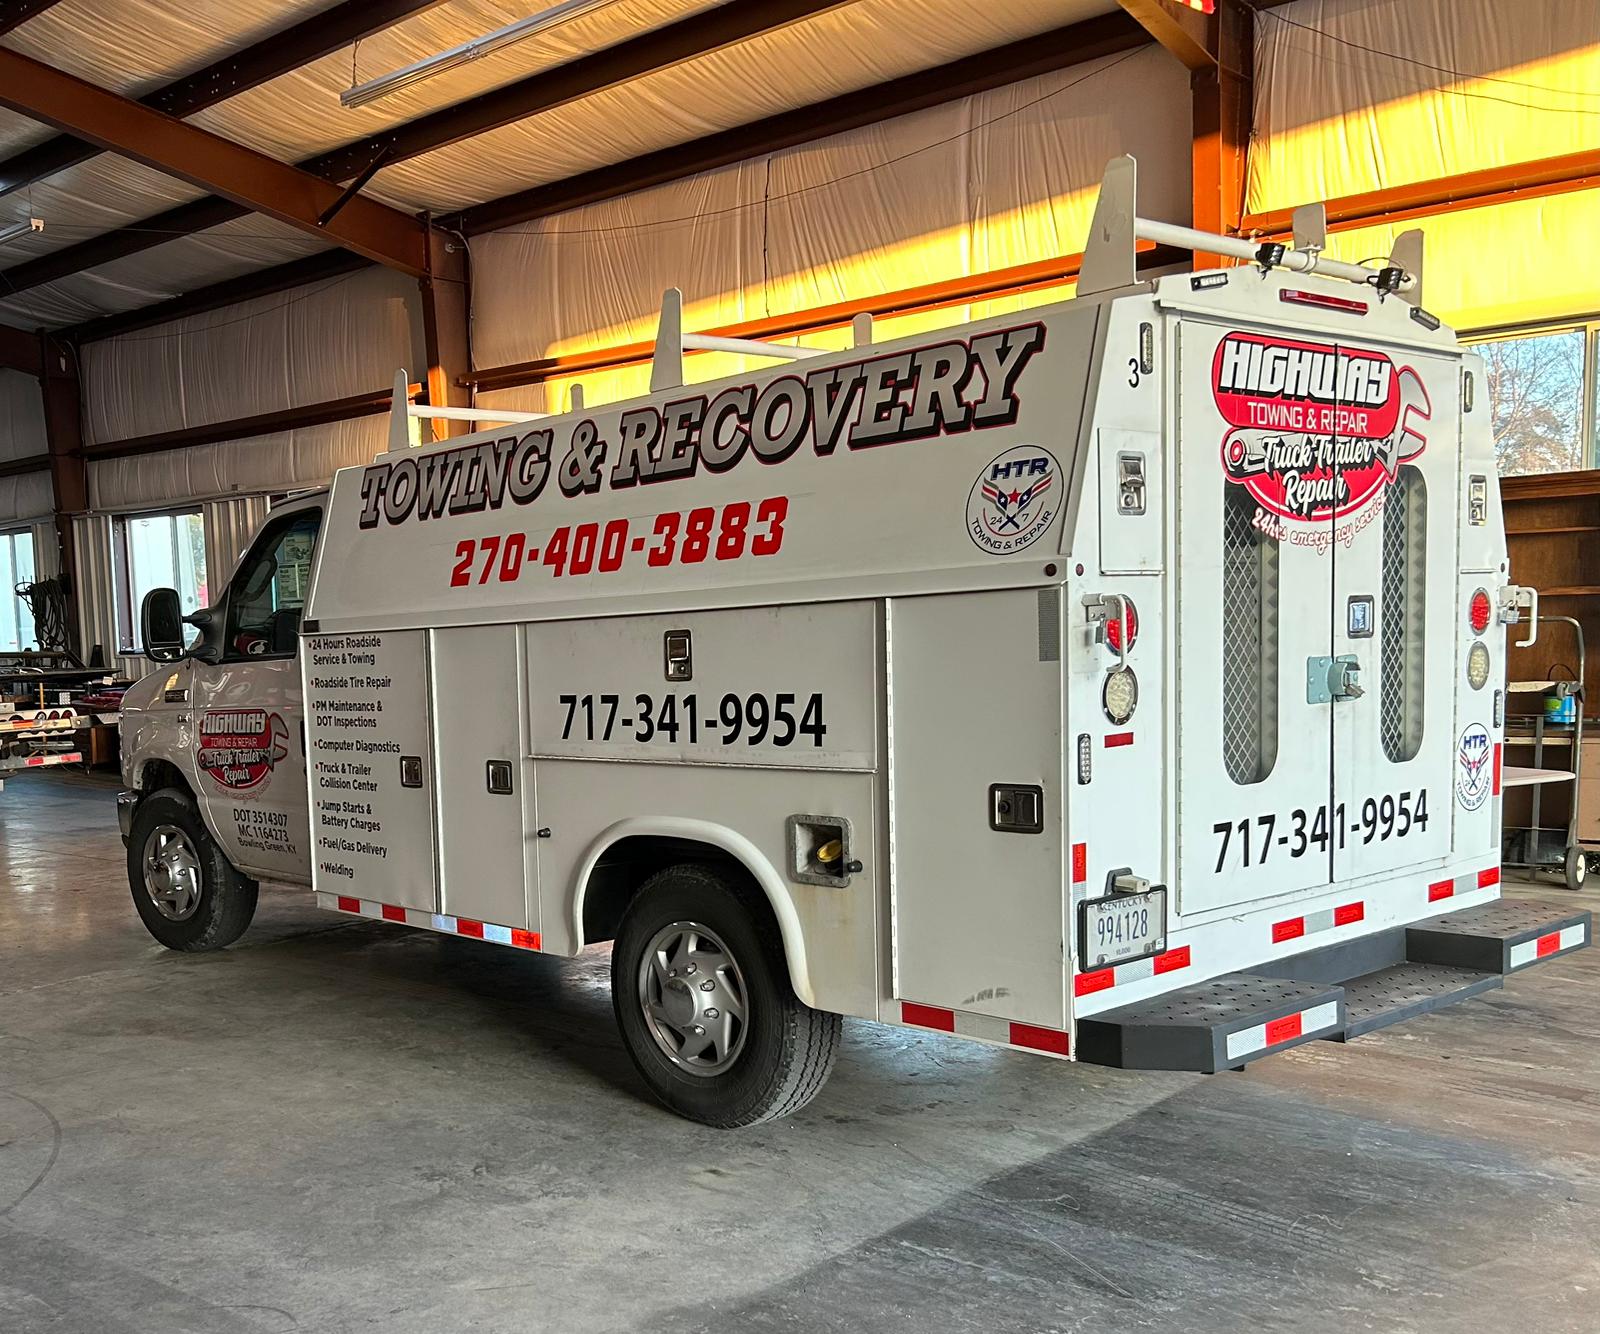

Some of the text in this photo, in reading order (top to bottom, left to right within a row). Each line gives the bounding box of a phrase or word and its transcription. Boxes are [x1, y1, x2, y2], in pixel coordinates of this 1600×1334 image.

[1128, 358, 1140, 388] 3
[1220, 340, 1392, 408] HIGHWAY
[359, 320, 1048, 530] TOWING & RECOVERY
[1247, 401, 1368, 434] TOWING & REPAIR
[990, 457, 1050, 481] HTR
[1282, 464, 1347, 515] Repair
[989, 513, 1030, 526] 24 7
[971, 510, 1053, 550] TOWING & REPAIR
[1251, 507, 1288, 541] 24hrs
[1290, 523, 1353, 556] emergency
[450, 495, 789, 588] 270-400-3883
[312, 635, 381, 651] 24 Hours Roadside
[313, 651, 376, 666] Service & Towing
[314, 675, 391, 690] Roadside Tire Repair
[316, 700, 383, 712] PM Maintenance &
[202, 713, 266, 735] HIGHWAY
[316, 715, 377, 729] DOT Inspections
[559, 692, 827, 747] 717-341-9954
[210, 737, 258, 747] TOWING & REPAIR
[318, 739, 401, 754] Computer Diagnostics
[1463, 734, 1487, 750] HTR
[222, 765, 251, 788] Repair
[319, 761, 372, 777] Truck & Trailer
[320, 777, 378, 792] Collision Center
[321, 800, 372, 815] Jump Starts &
[233, 808, 288, 827] DOT 3514307
[321, 815, 381, 833] Battery Charges
[237, 824, 289, 842] MC 1164273
[1213, 789, 1429, 873] 717-341-9954
[237, 837, 265, 851] Bowling
[286, 844, 297, 855] KY
[322, 837, 388, 858] Fuel/Gas Delivery
[323, 862, 354, 879] Welding
[1098, 909, 1148, 946] 994128
